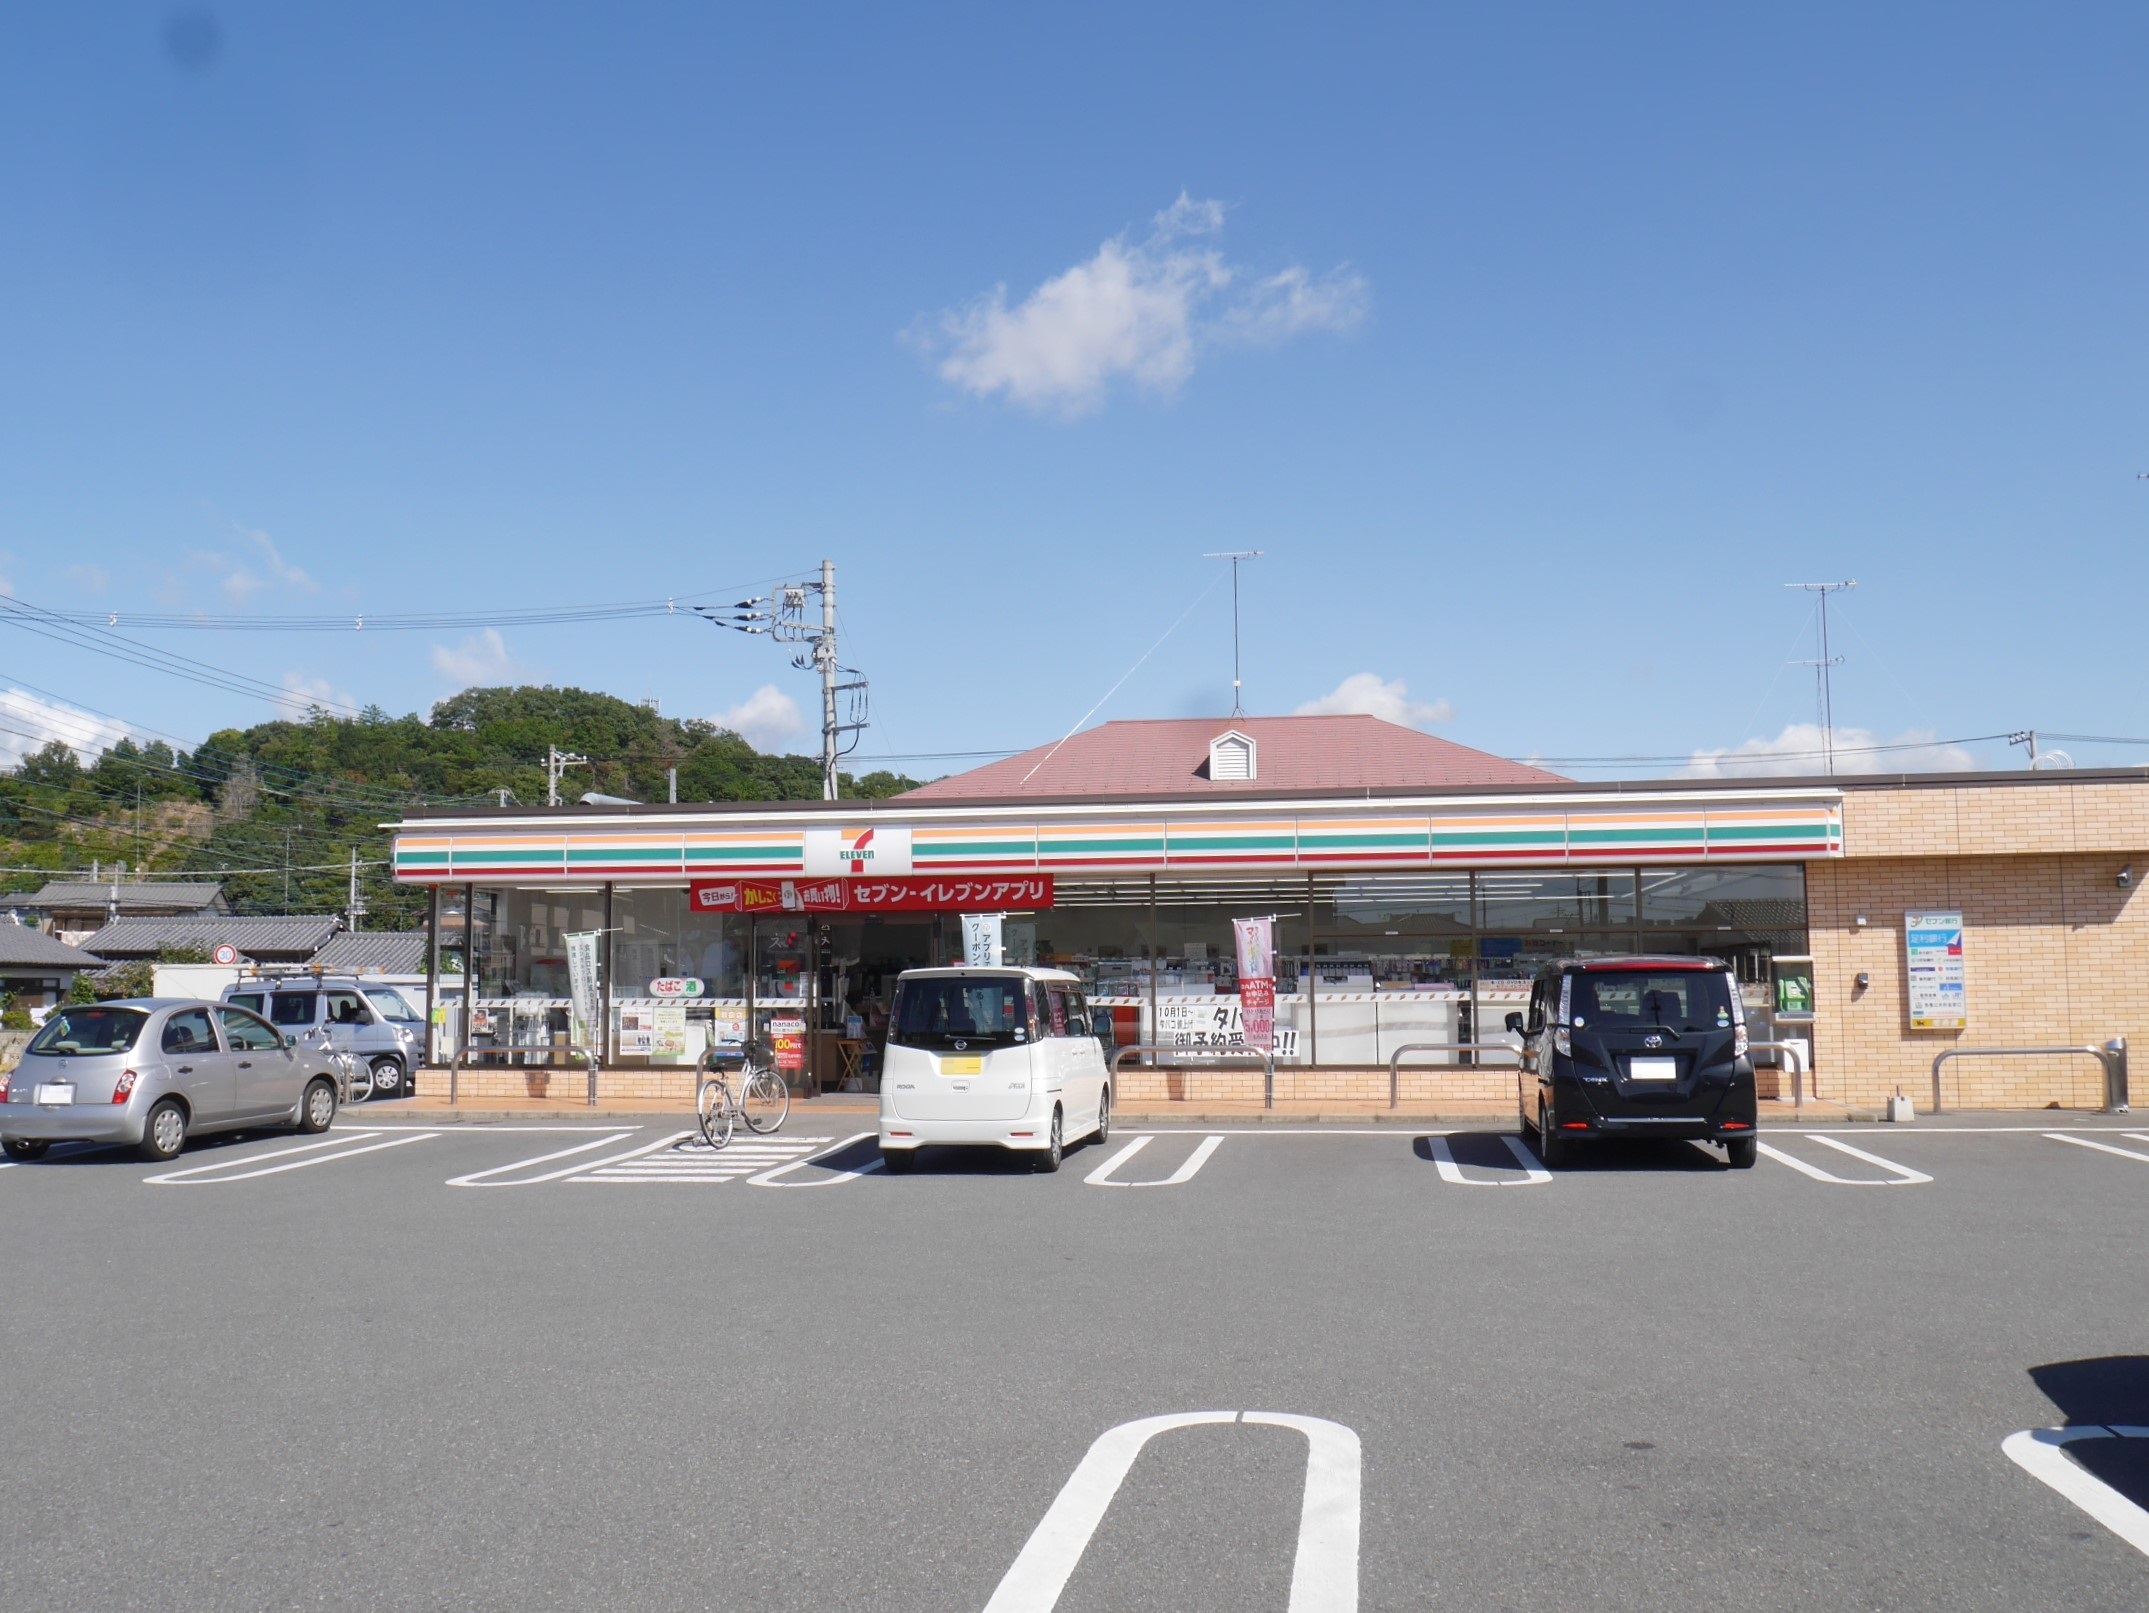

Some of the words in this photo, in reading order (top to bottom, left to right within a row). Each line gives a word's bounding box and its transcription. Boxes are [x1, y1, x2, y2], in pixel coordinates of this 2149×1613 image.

[220, 950, 232, 960] 30
[656, 980, 682, 993] たばこ
[685, 980, 698, 993] 酒
